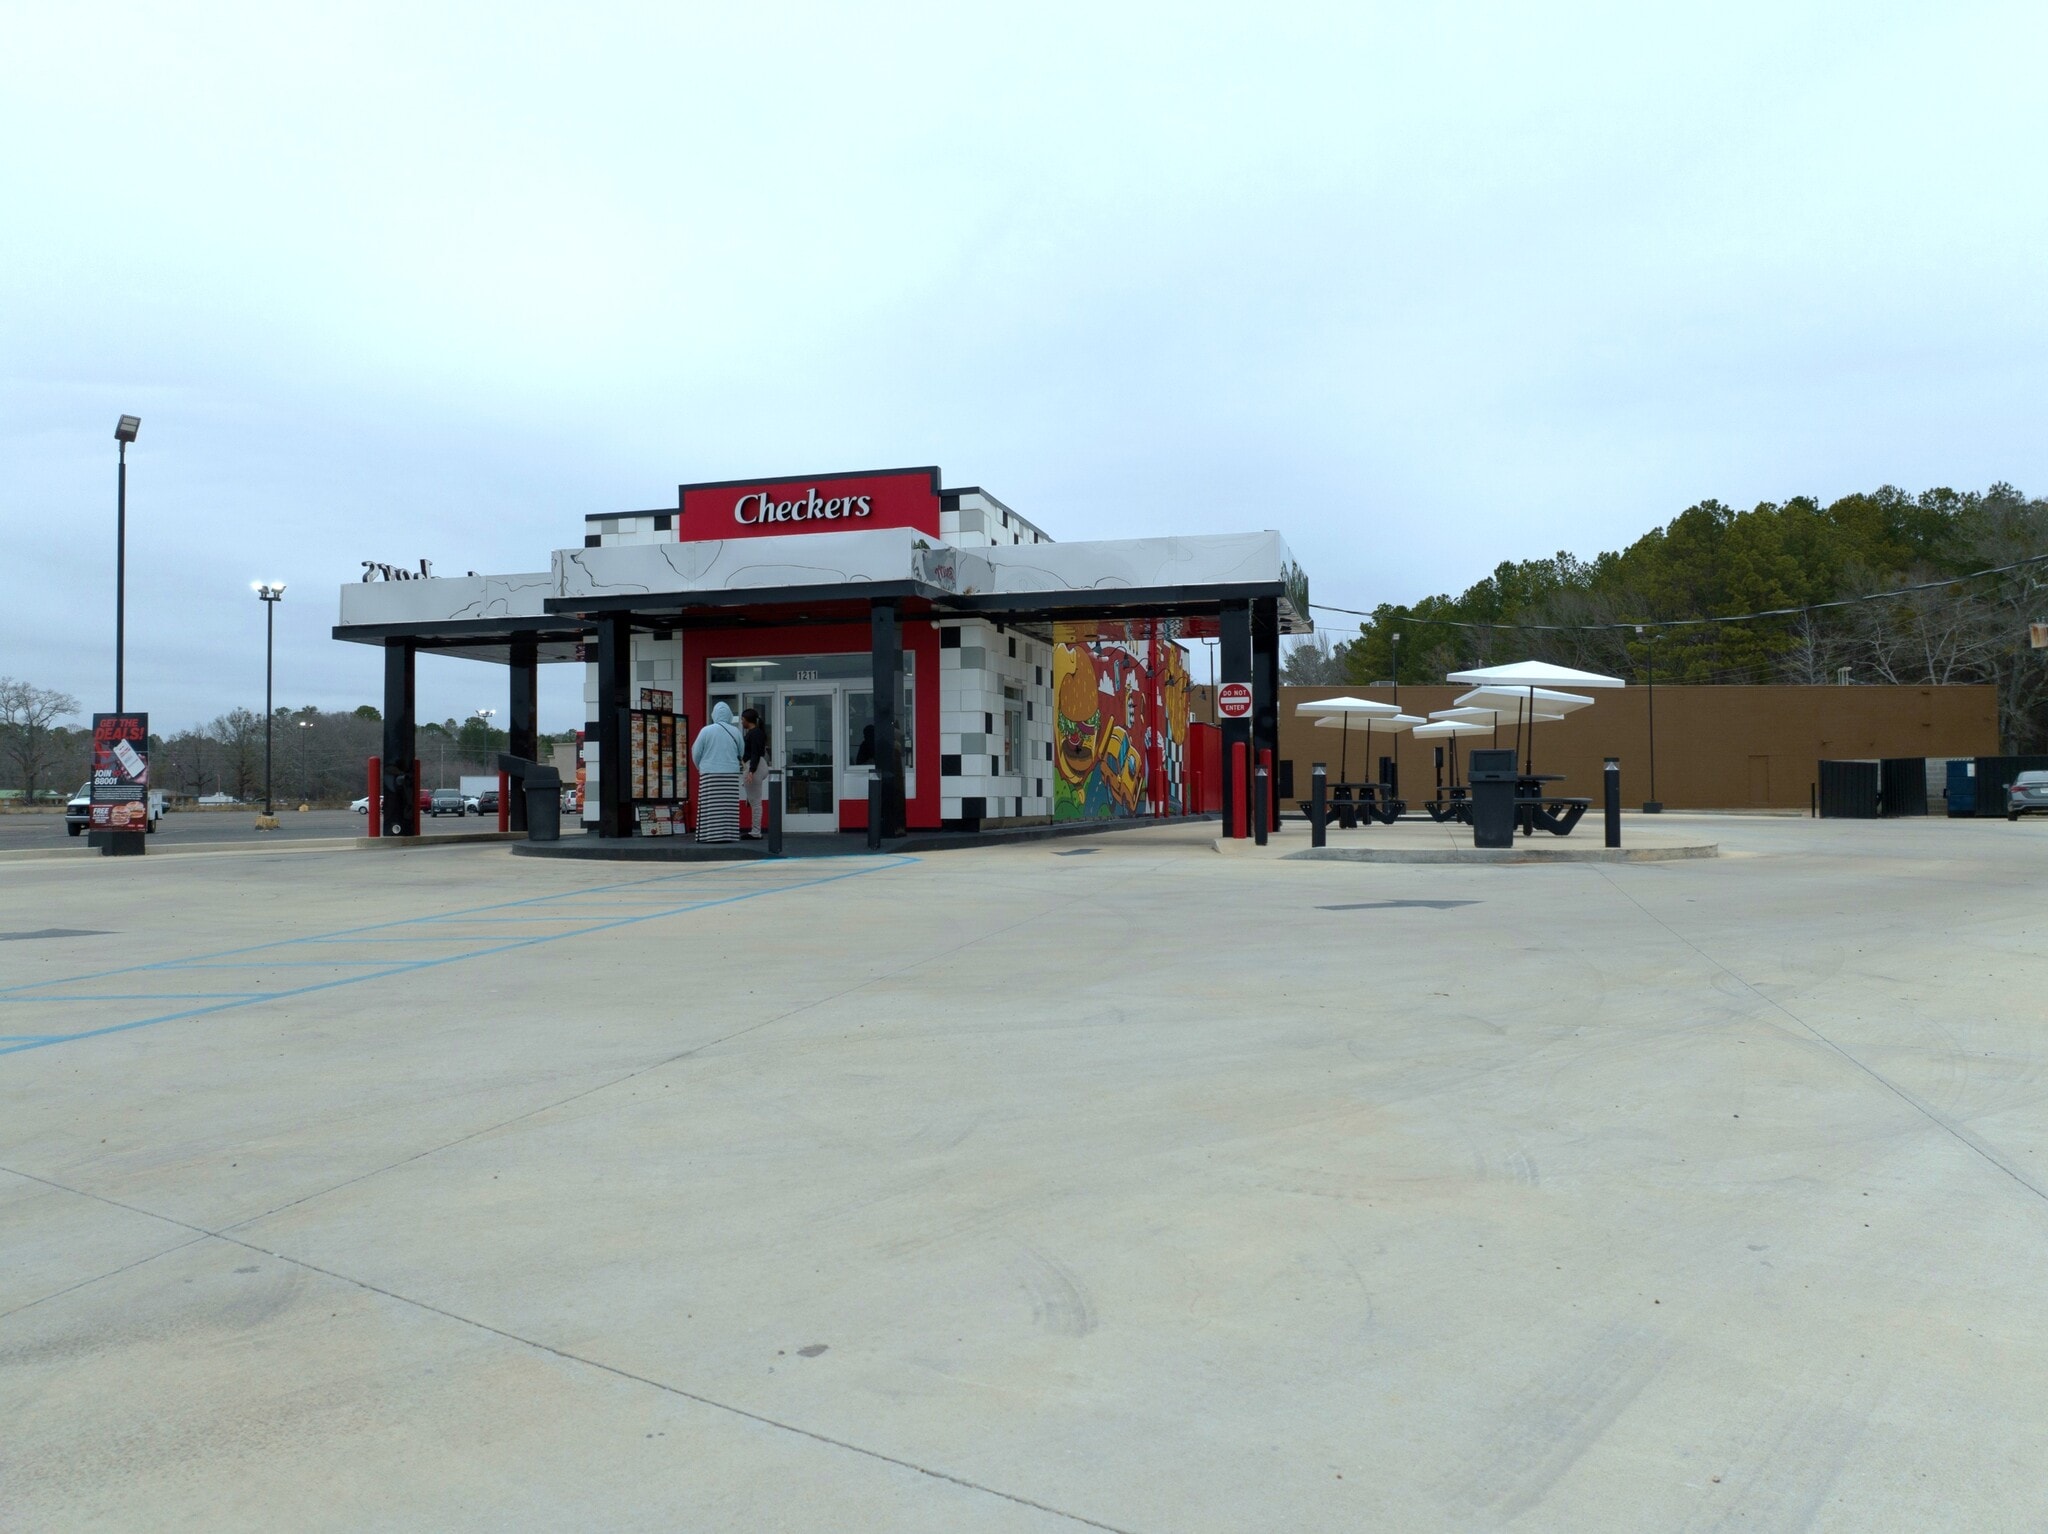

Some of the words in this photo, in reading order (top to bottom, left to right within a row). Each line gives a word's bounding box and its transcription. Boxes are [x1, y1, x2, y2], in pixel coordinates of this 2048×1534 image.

[734, 488, 871, 524] Checkers
[797, 671, 818, 680] 1211
[100, 719, 117, 728] GET
[120, 718, 139, 728] THE
[95, 727, 145, 740] DEALS!
